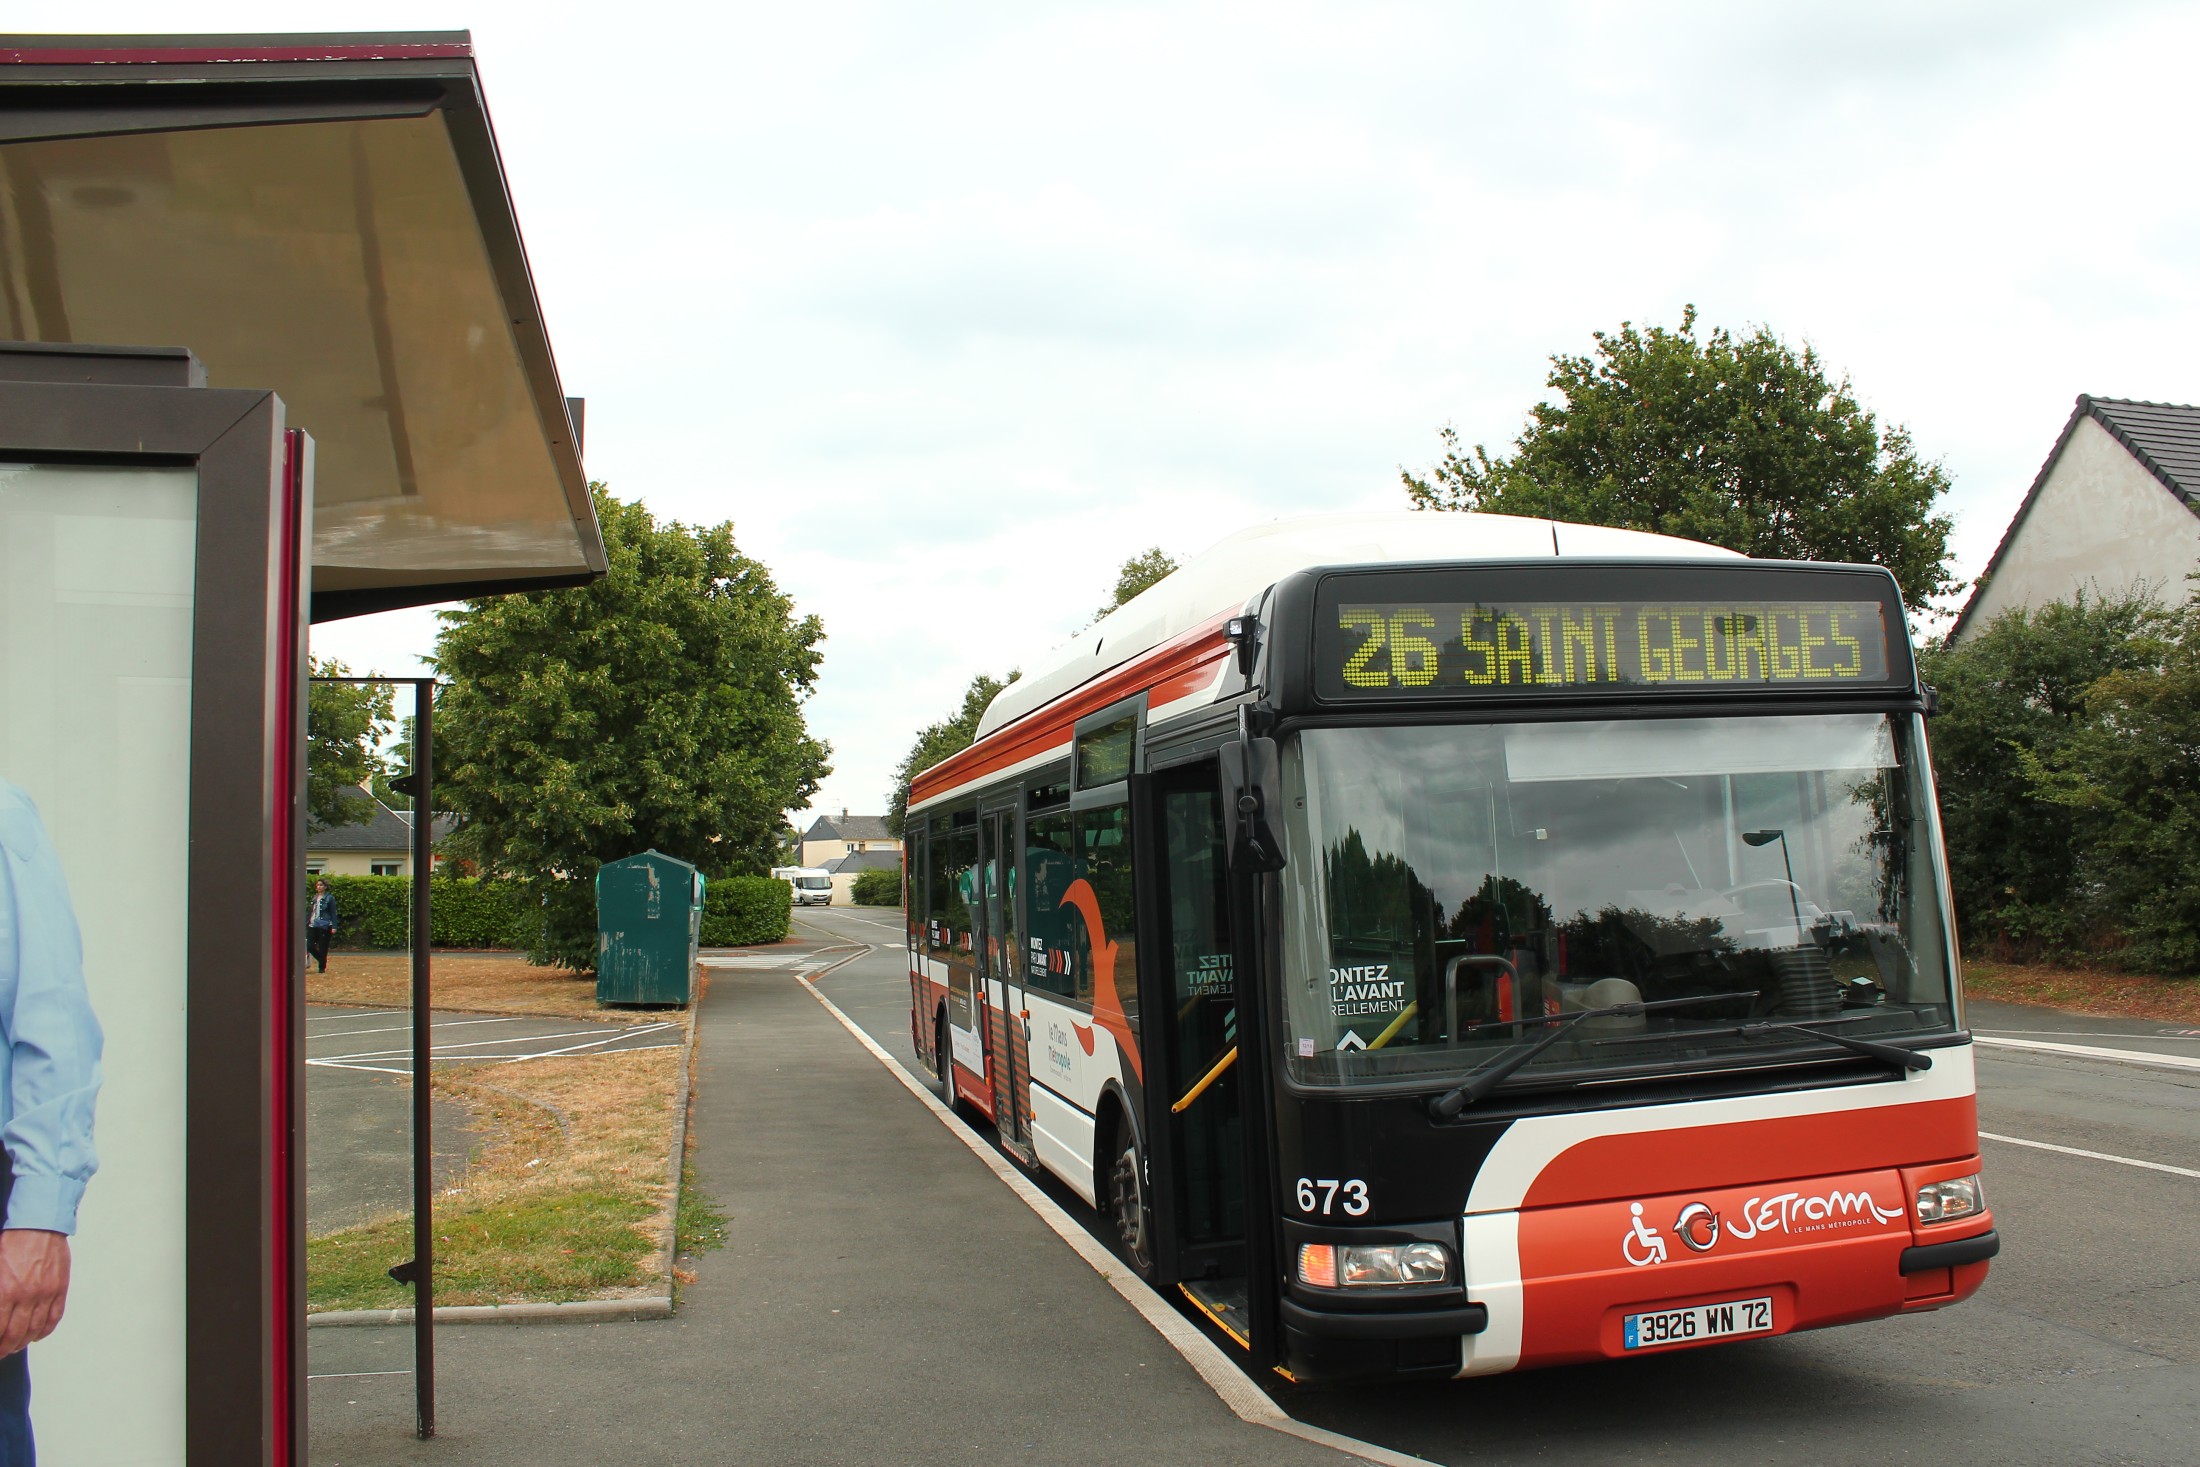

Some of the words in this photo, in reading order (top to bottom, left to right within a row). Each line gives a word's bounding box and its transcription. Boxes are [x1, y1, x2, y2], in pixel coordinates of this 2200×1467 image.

[1340, 608, 1438, 687] 26
[1461, 607, 1622, 685] SAINT
[1637, 604, 1860, 681] GEORGES
[1332, 981, 1405, 1003] L'AVANT
[1296, 1177, 1370, 1216] 673
[1794, 1226, 1803, 1234] LE
[1805, 1223, 1826, 1232] MANS
[1828, 1217, 1871, 1229] MÉTROPOLE
[1642, 1311, 1696, 1343] 3926
[1706, 1305, 1734, 1334] WN
[1741, 1301, 1768, 1329] 72
[1627, 1334, 1634, 1344] F
